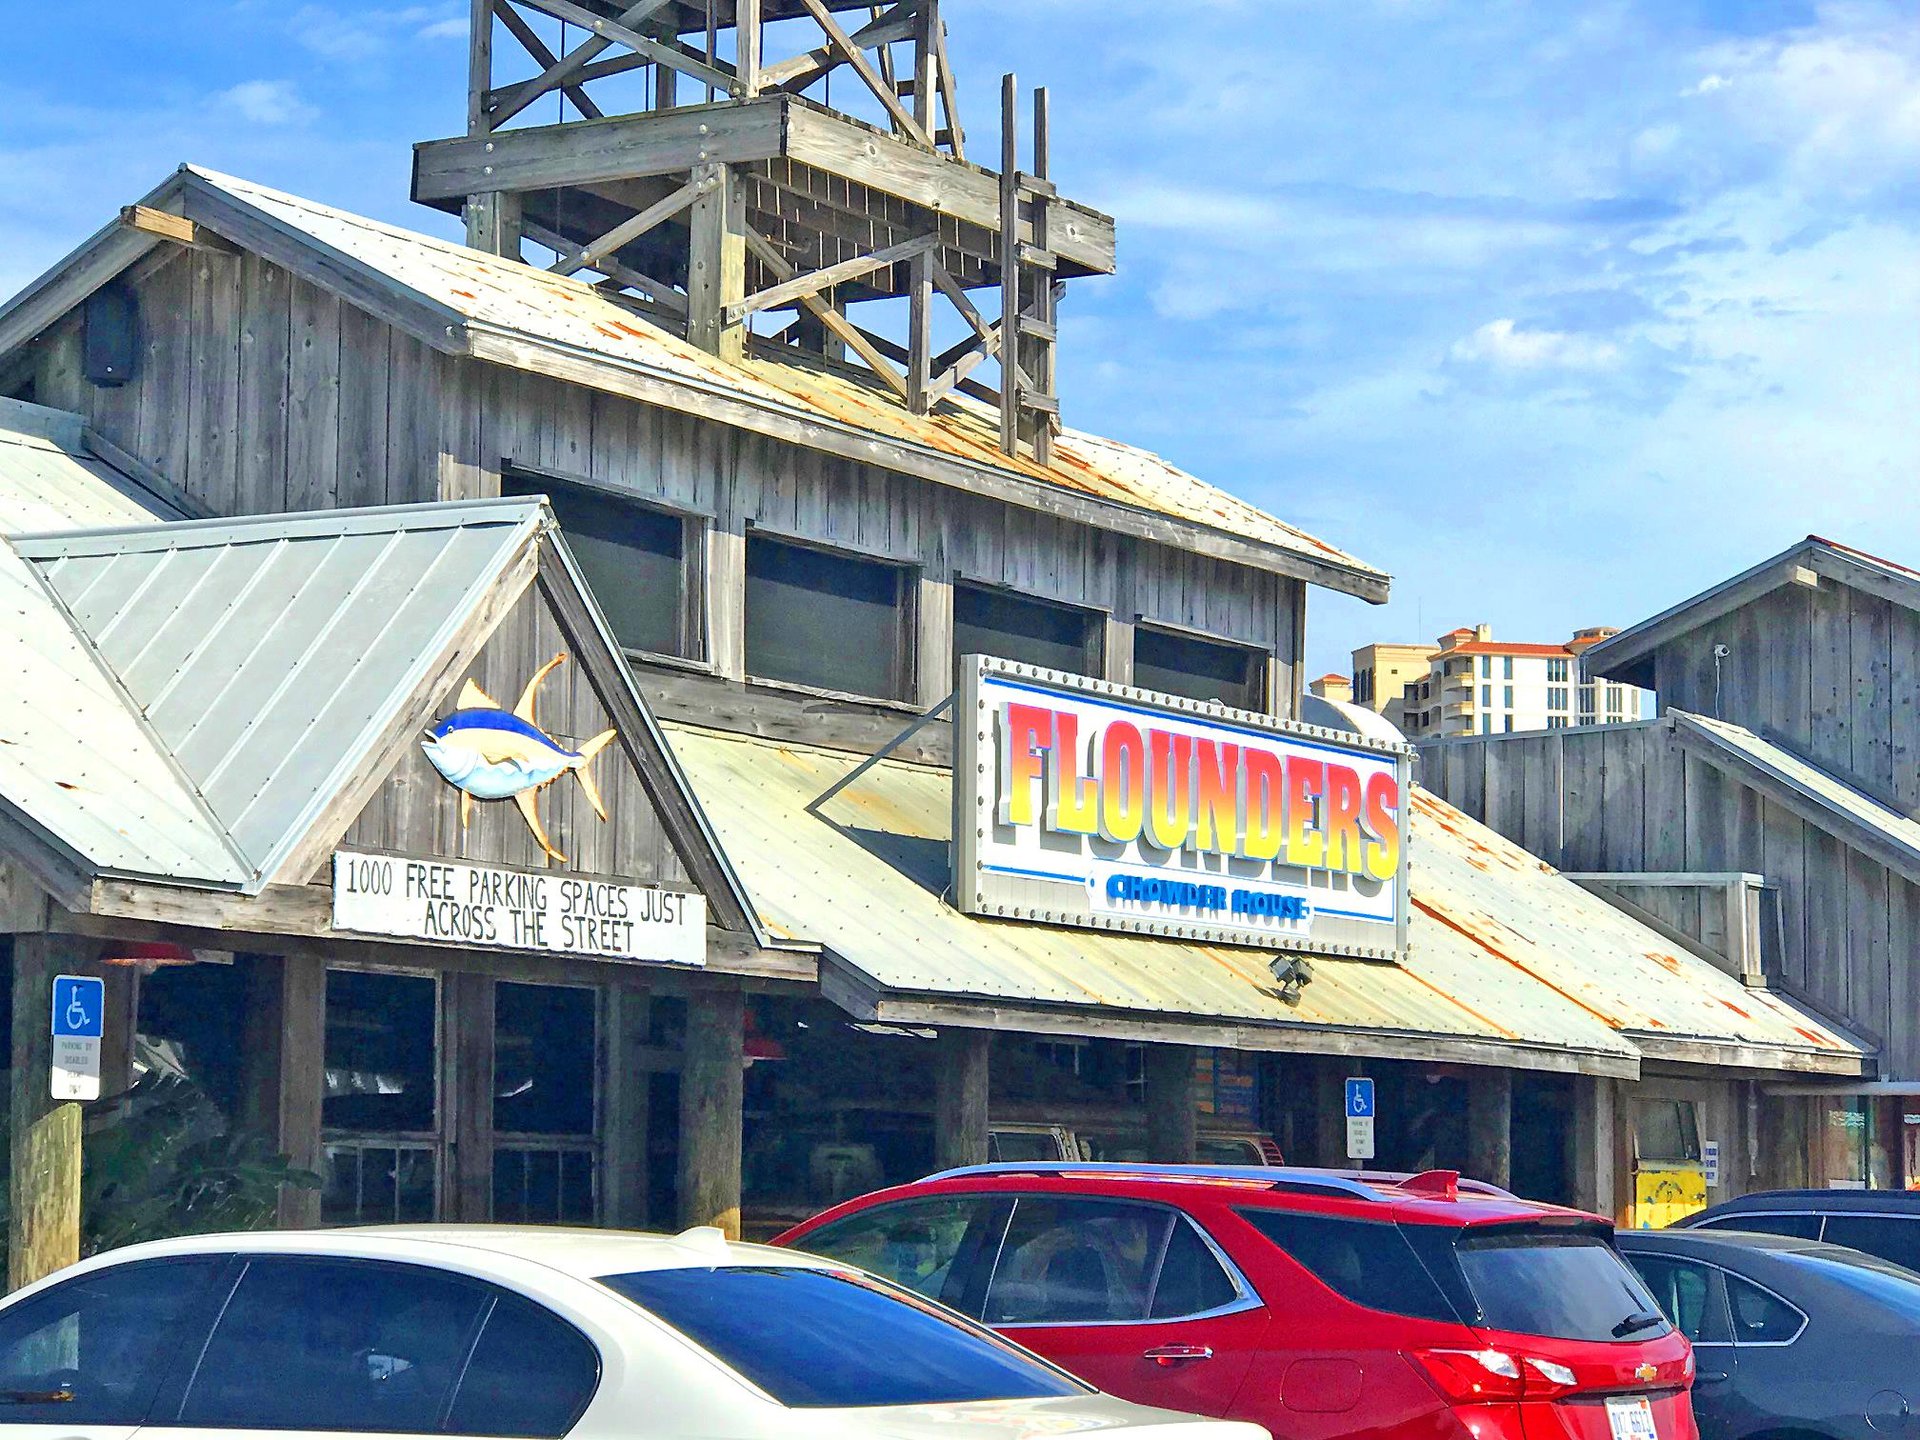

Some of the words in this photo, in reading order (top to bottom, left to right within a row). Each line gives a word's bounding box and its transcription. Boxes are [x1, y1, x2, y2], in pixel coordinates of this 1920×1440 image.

[1000, 702, 1400, 883] FLOUNDERS
[346, 858, 392, 896] 1000
[405, 862, 455, 901] FREE
[469, 869, 548, 911] PARKING
[560, 880, 629, 919] SPACES
[640, 889, 686, 926] JUST
[1106, 873, 1227, 911] CHOWDER
[1231, 888, 1309, 921] HOUSE
[424, 900, 498, 941] ACROSS
[509, 908, 549, 948] THE
[561, 914, 634, 953] STREET
